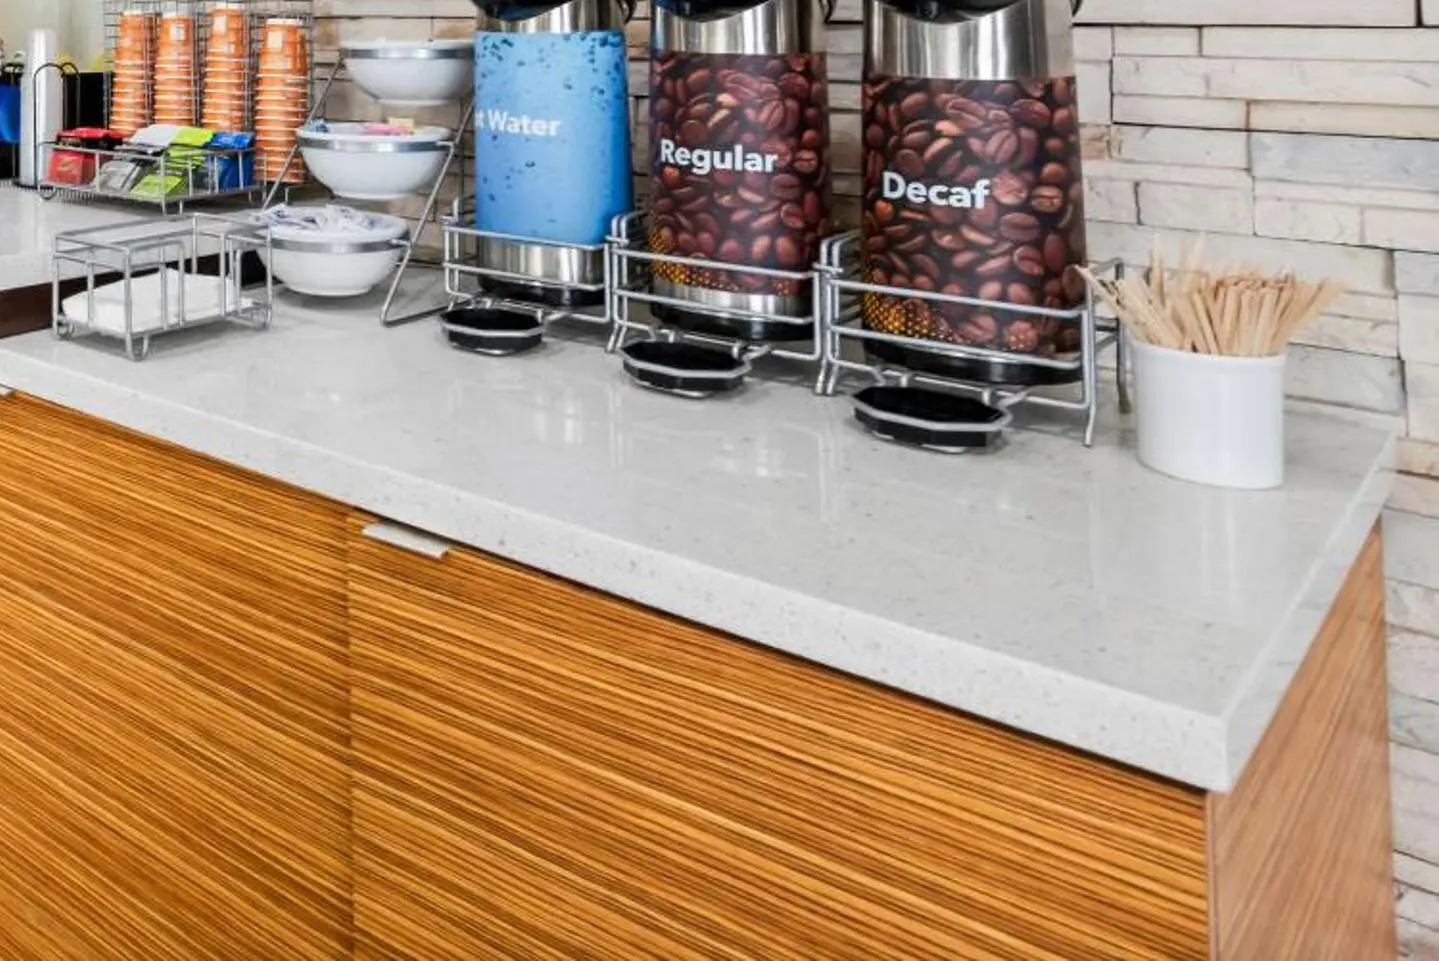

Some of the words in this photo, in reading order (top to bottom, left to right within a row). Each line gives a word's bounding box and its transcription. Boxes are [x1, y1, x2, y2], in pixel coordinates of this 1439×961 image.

[488, 109, 561, 137] Water
[659, 138, 780, 176] Regular
[882, 172, 992, 210] Decaf
